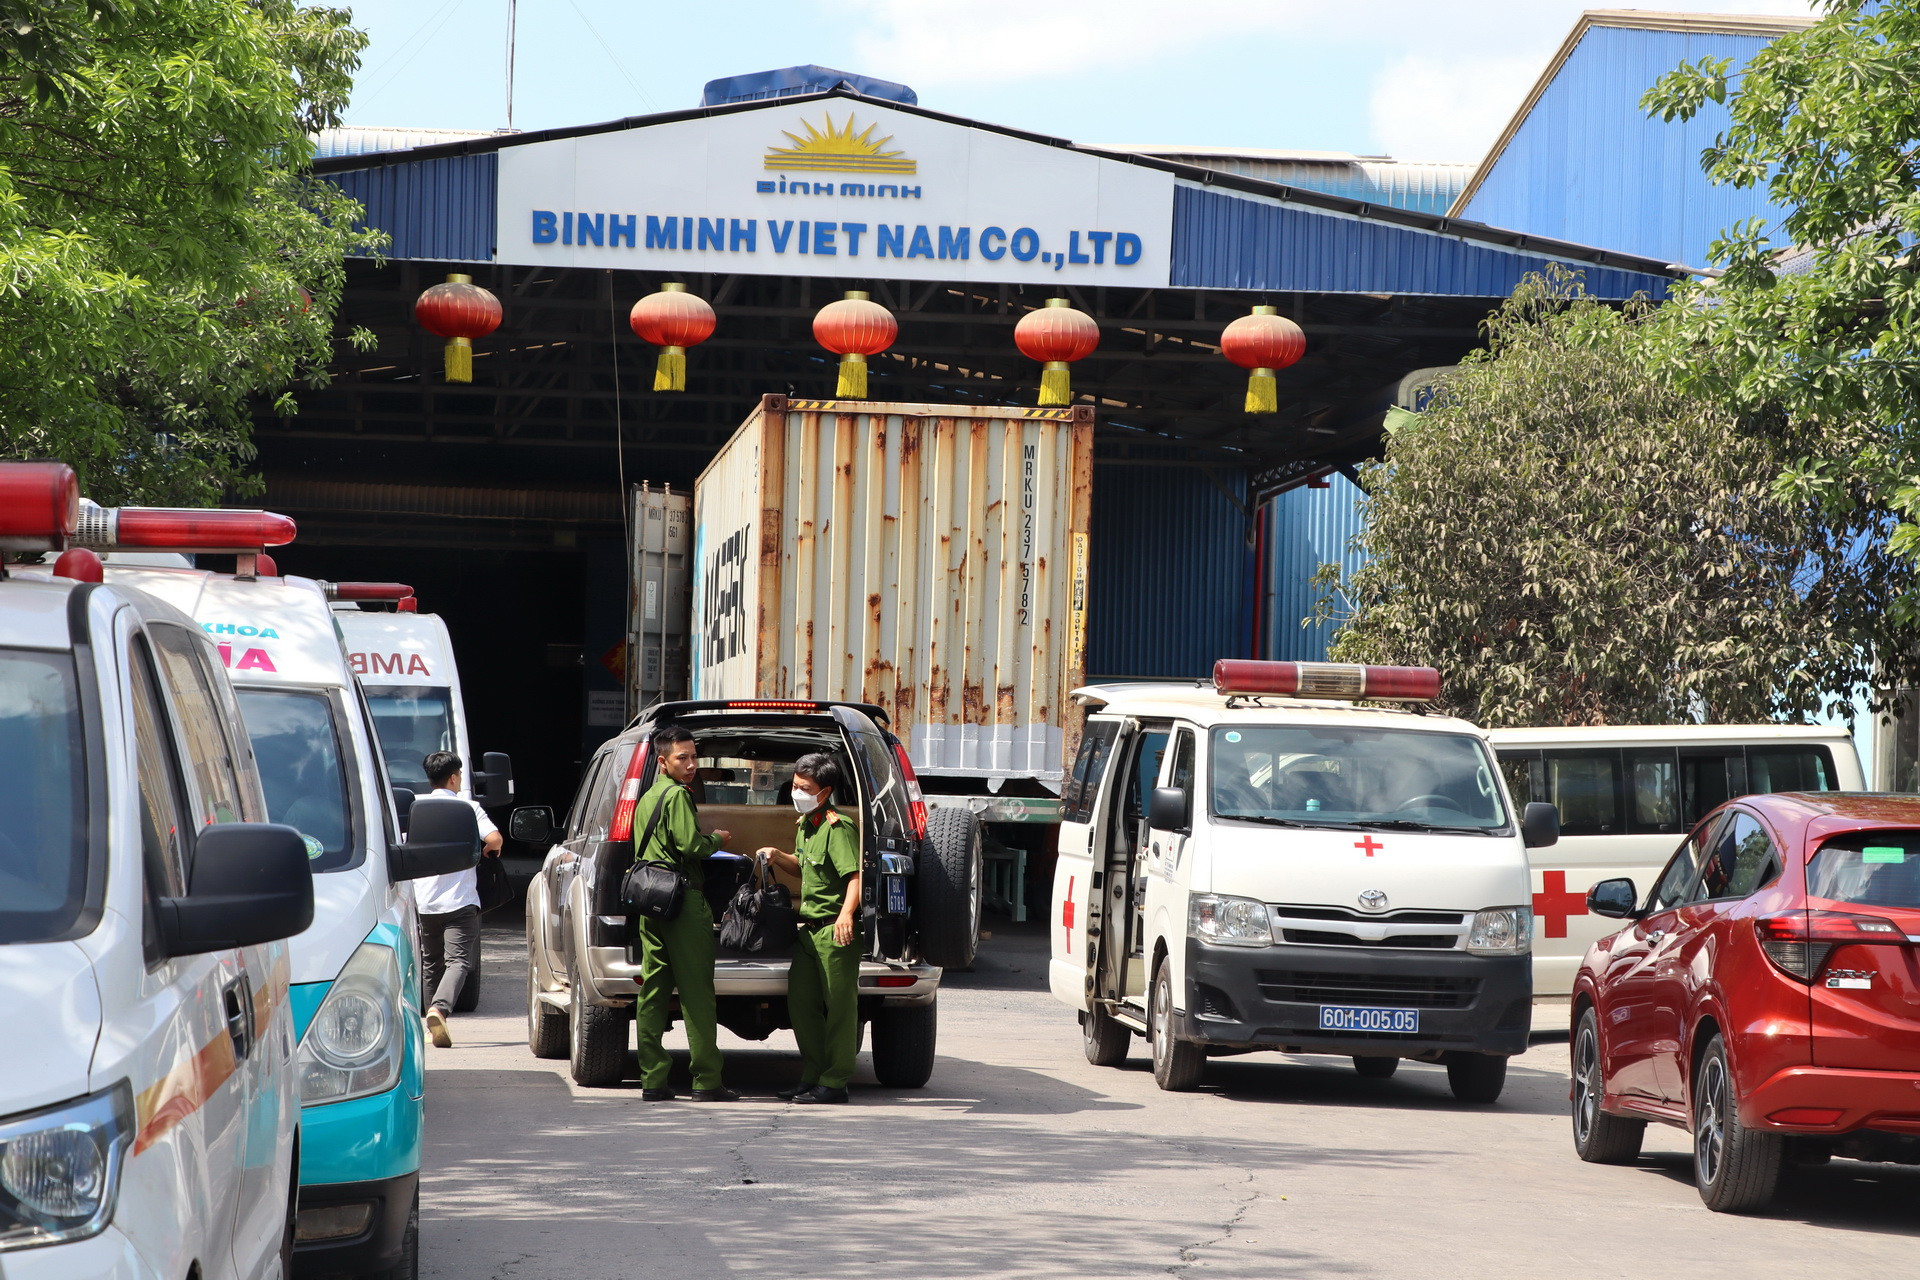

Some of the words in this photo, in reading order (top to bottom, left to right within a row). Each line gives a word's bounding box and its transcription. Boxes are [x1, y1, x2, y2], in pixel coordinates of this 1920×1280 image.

[532, 210, 637, 248] BINH
[645, 215, 757, 252] MINH
[767, 219, 867, 256] VIET
[877, 224, 970, 260] NAM
[1024, 445, 1035, 508] MRKU
[197, 622, 280, 639] KHOA
[890, 895, 905, 911] 6789
[1826, 969, 1877, 979] HR-V
[1323, 1008, 1416, 1030] 60M-005.05
